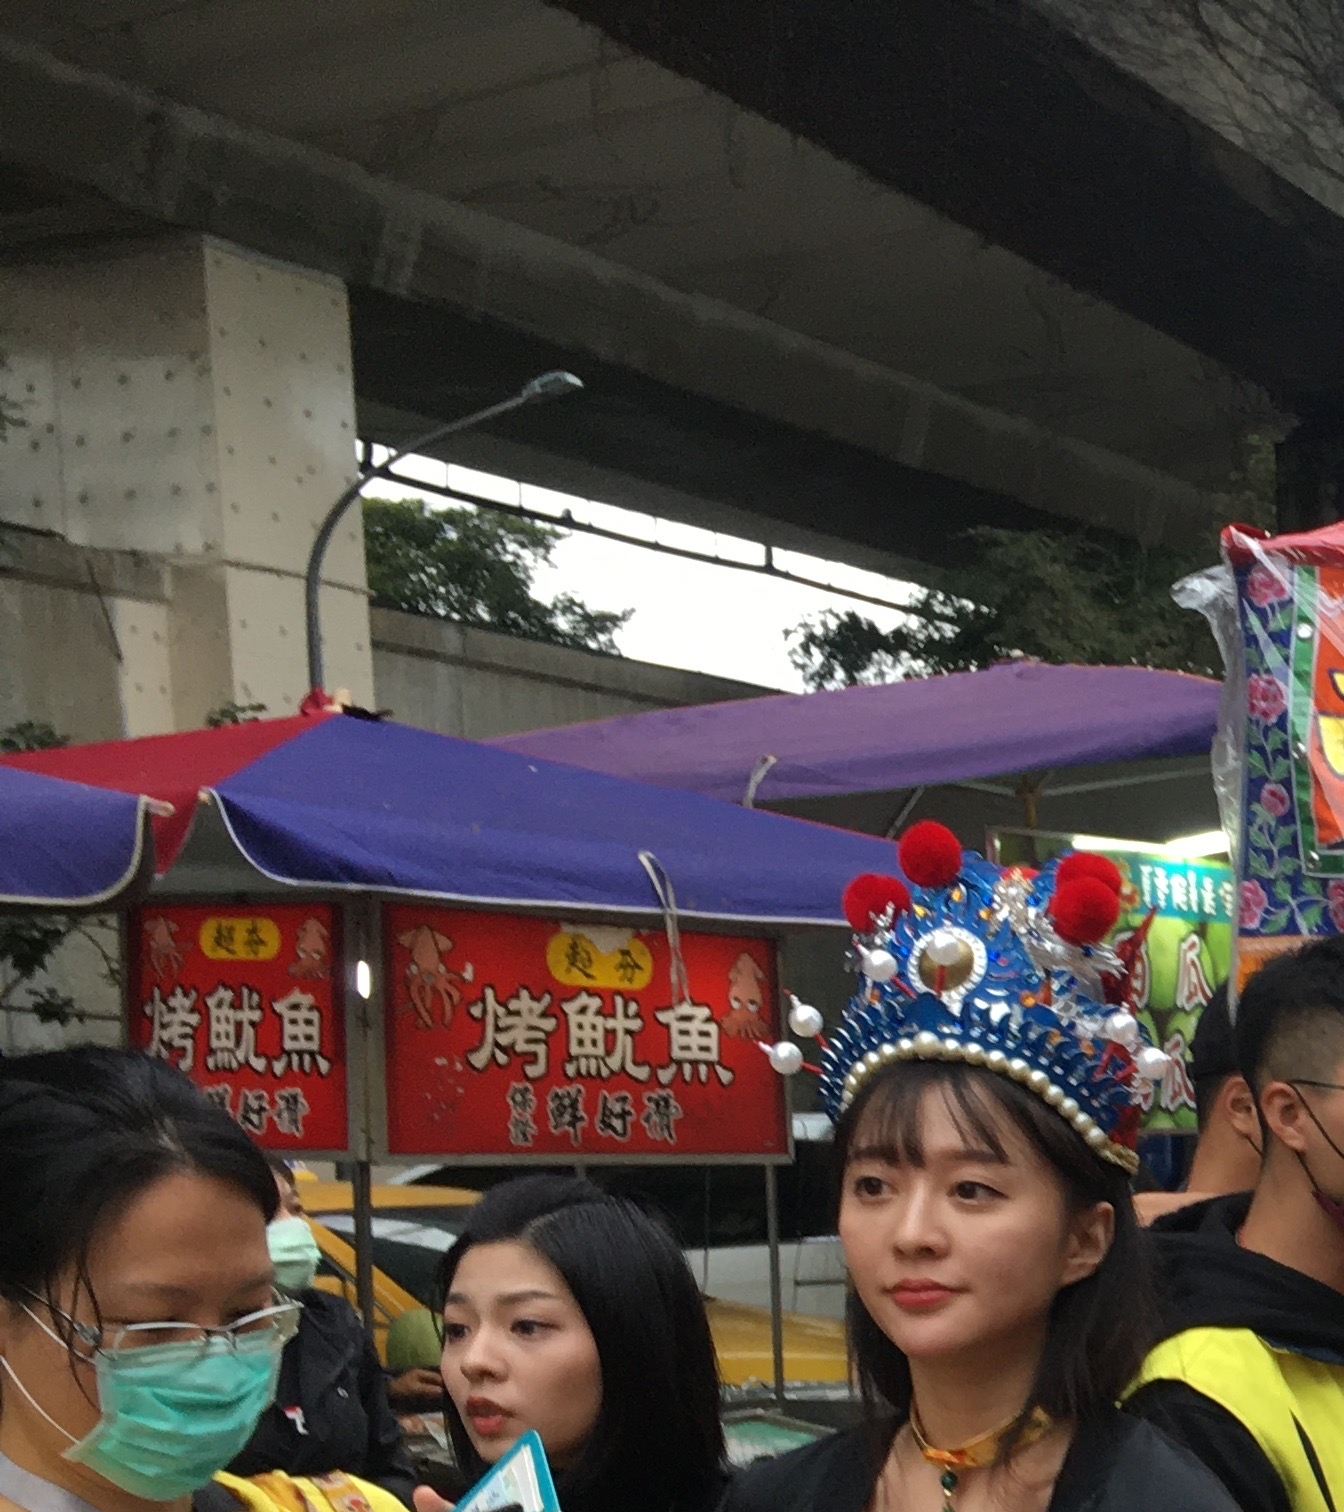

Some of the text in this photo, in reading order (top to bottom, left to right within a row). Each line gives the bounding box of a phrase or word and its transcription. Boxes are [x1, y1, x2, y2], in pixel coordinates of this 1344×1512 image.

[144, 982, 332, 1078] 烤魷魚
[465, 984, 736, 1087] 烤魷魚
